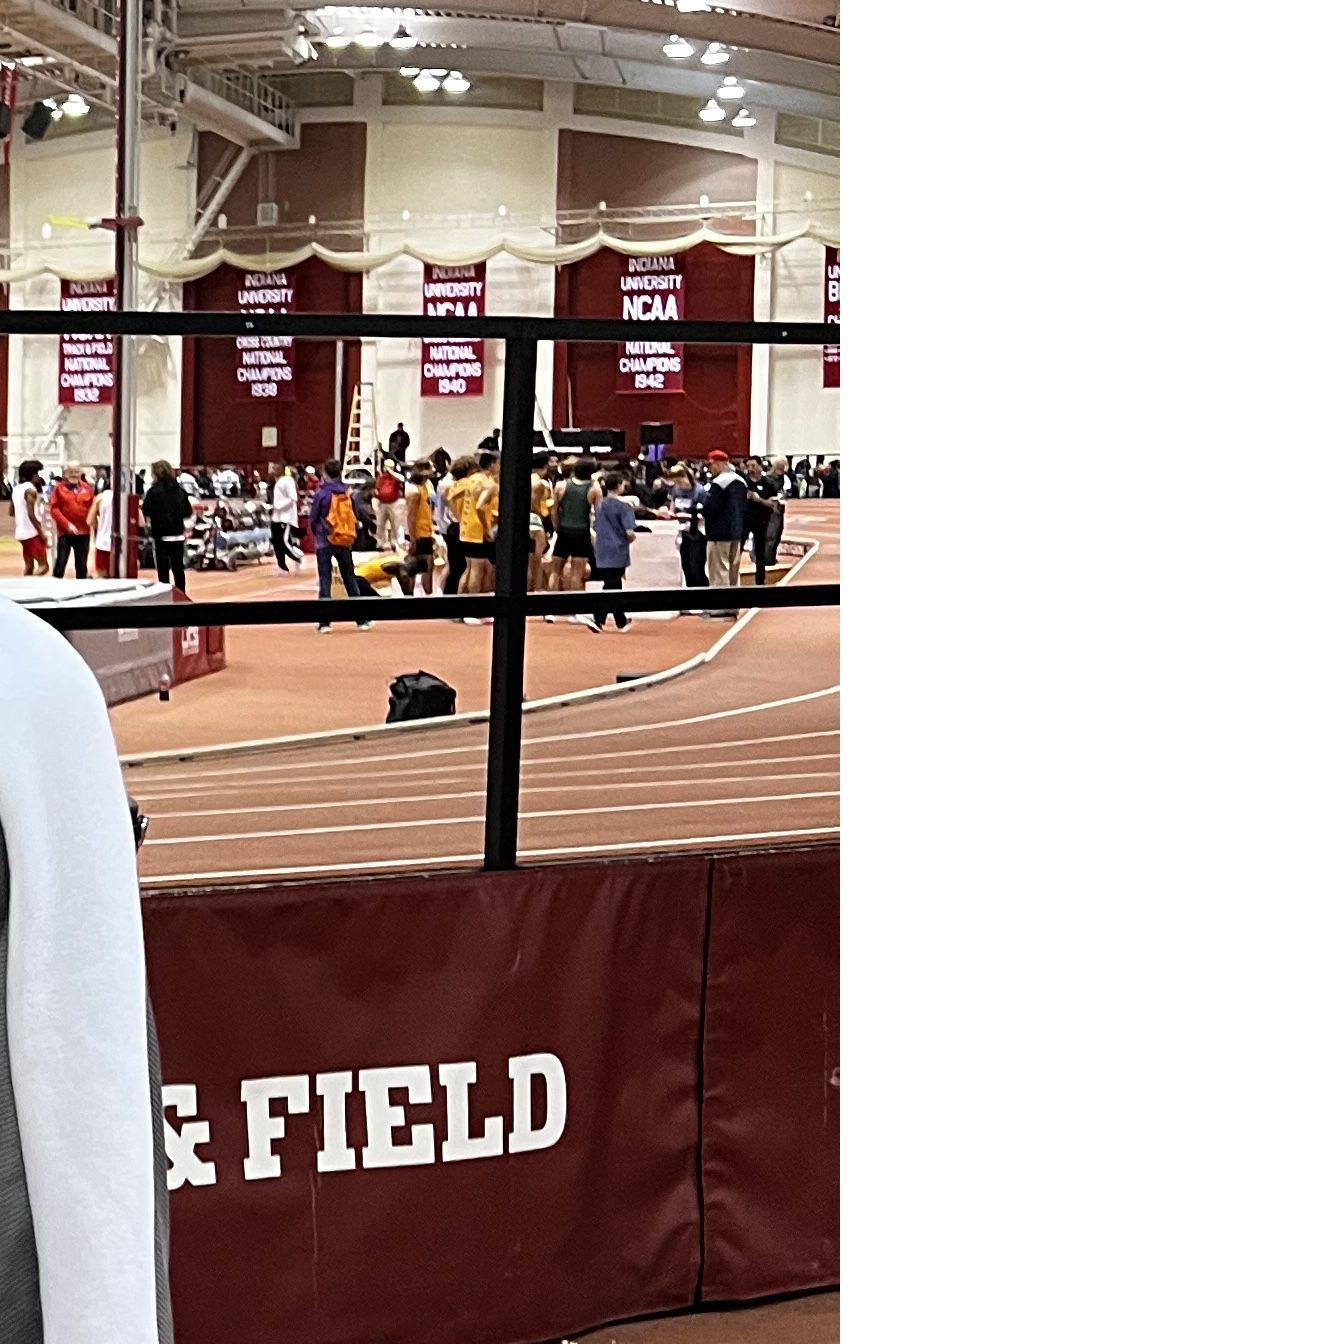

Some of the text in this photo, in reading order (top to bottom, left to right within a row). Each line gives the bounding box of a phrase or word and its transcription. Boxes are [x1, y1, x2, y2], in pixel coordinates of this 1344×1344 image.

[628, 255, 676, 272] INDIANA
[244, 272, 288, 288] INDIANA
[620, 274, 683, 291] UNIVERSITY
[237, 287, 293, 305] UNIVERSITY
[424, 281, 483, 298] UNIVERSITY
[622, 293, 679, 321] NCAA
[429, 344, 477, 360] NATIONAL
[625, 341, 676, 355] NATIONAL
[64, 357, 111, 371] NATIONAL
[242, 349, 288, 365] NATIONAL
[619, 356, 682, 373] CHAMPIONS
[236, 366, 293, 382] CHAMPIONS
[423, 362, 482, 378] CHAMPIONS
[60, 372, 114, 388] CHAMPIONS
[634, 373, 665, 389] 1942
[240, 1052, 568, 1181] FIELD
